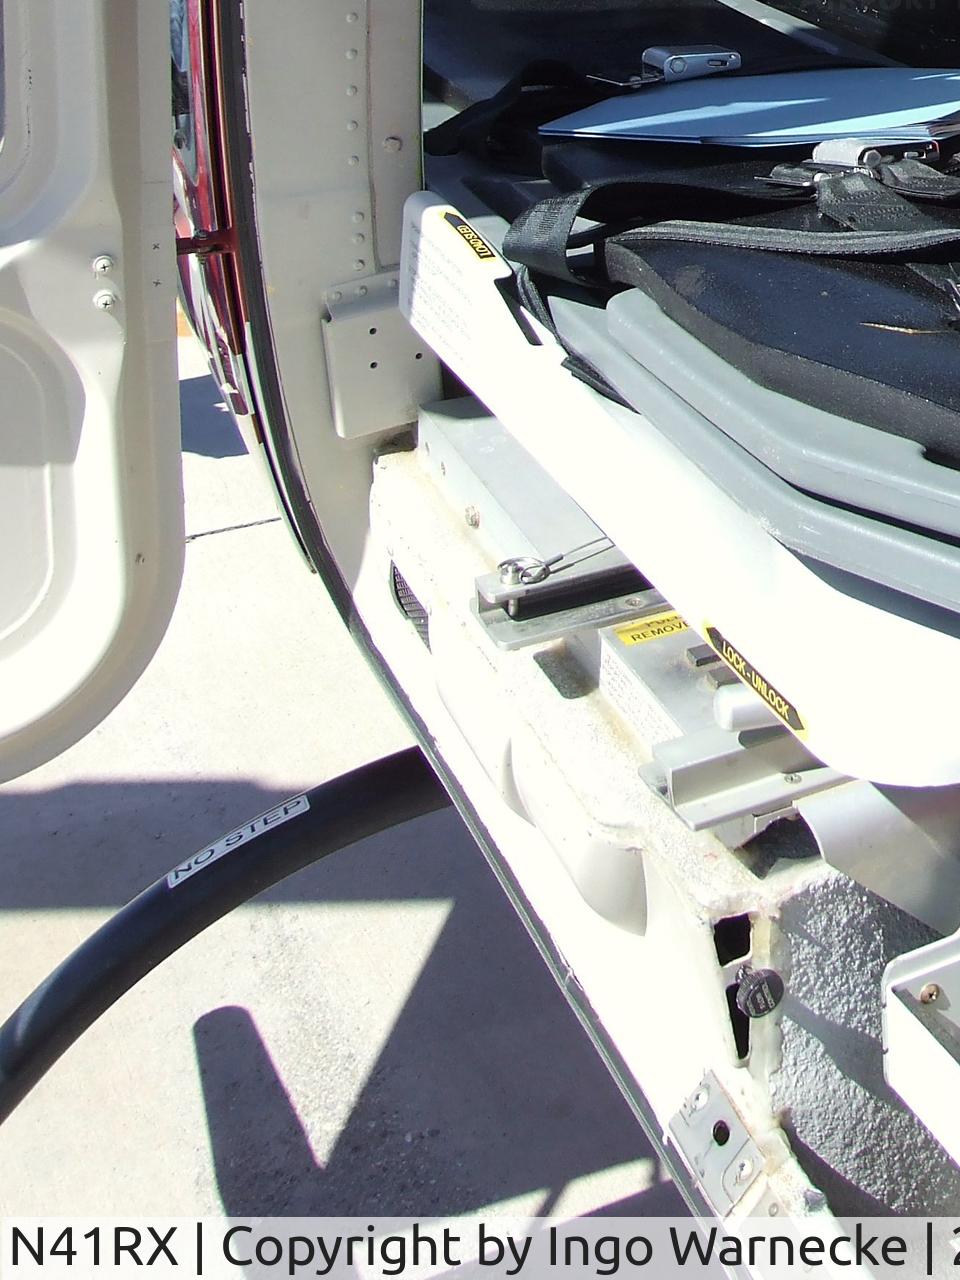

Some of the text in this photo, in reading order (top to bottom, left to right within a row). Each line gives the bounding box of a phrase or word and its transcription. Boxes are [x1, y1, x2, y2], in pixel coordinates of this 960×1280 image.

[722, 640, 746, 676] LOCK
[751, 670, 790, 720] UNLOCK
[174, 800, 301, 880] NO STEP
